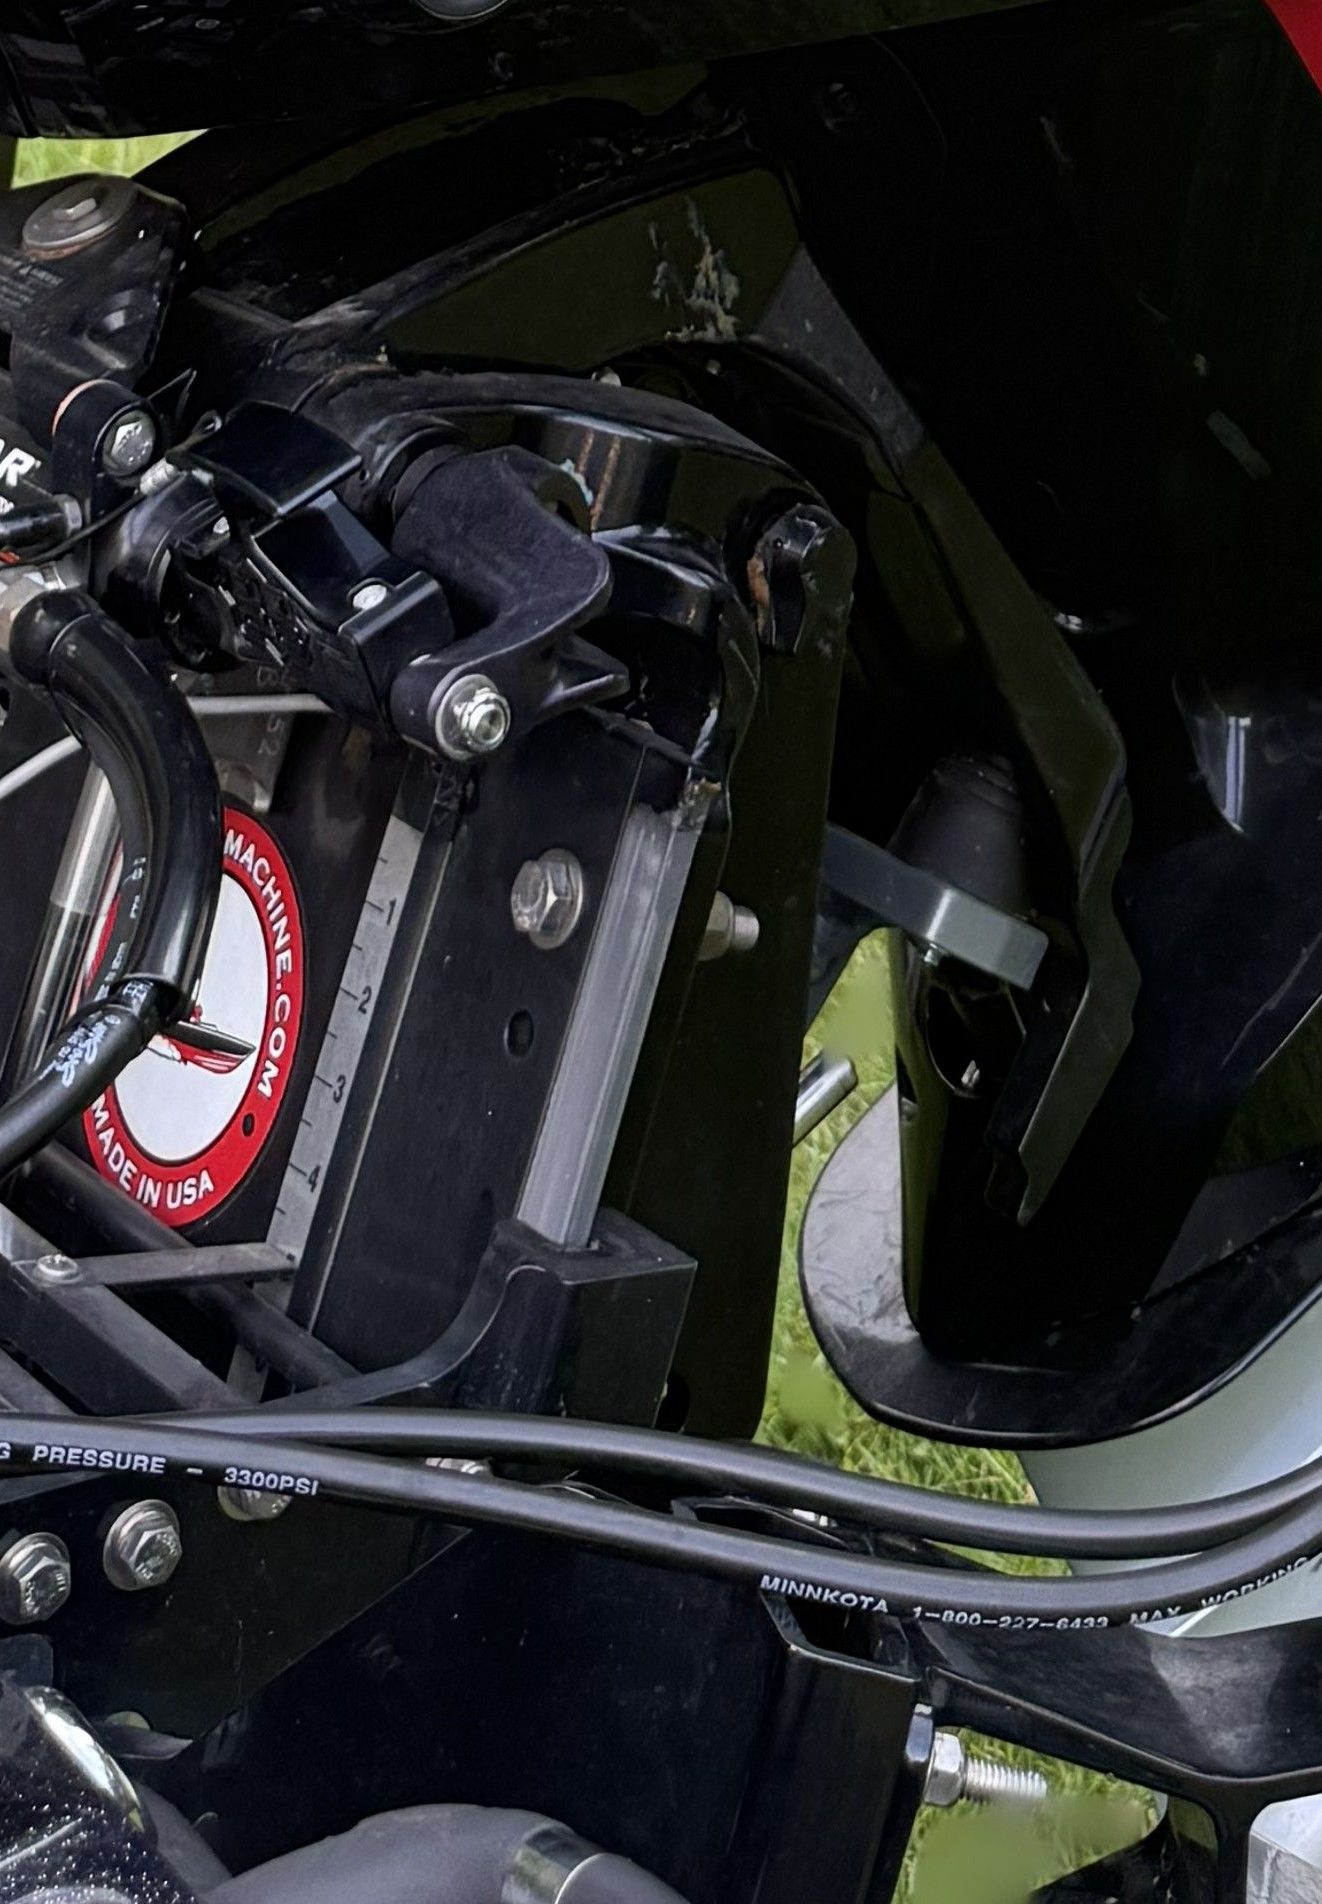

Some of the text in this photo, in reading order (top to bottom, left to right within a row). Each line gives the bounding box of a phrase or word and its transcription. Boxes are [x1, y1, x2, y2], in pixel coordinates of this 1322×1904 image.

[383, 897, 397, 927] 1
[357, 985, 373, 1016] 2
[332, 1073, 347, 1103] 3
[90, 1096, 215, 1210] MADE IN USA
[306, 1163, 322, 1193] 4
[31, 1444, 169, 1475] PRESSURE
[223, 1466, 320, 1497] 3300PSI
[760, 1574, 889, 1615] MINNKOTA
[911, 1606, 1110, 1630] 1-800-227-6433
[1129, 1605, 1182, 1625] MAX
